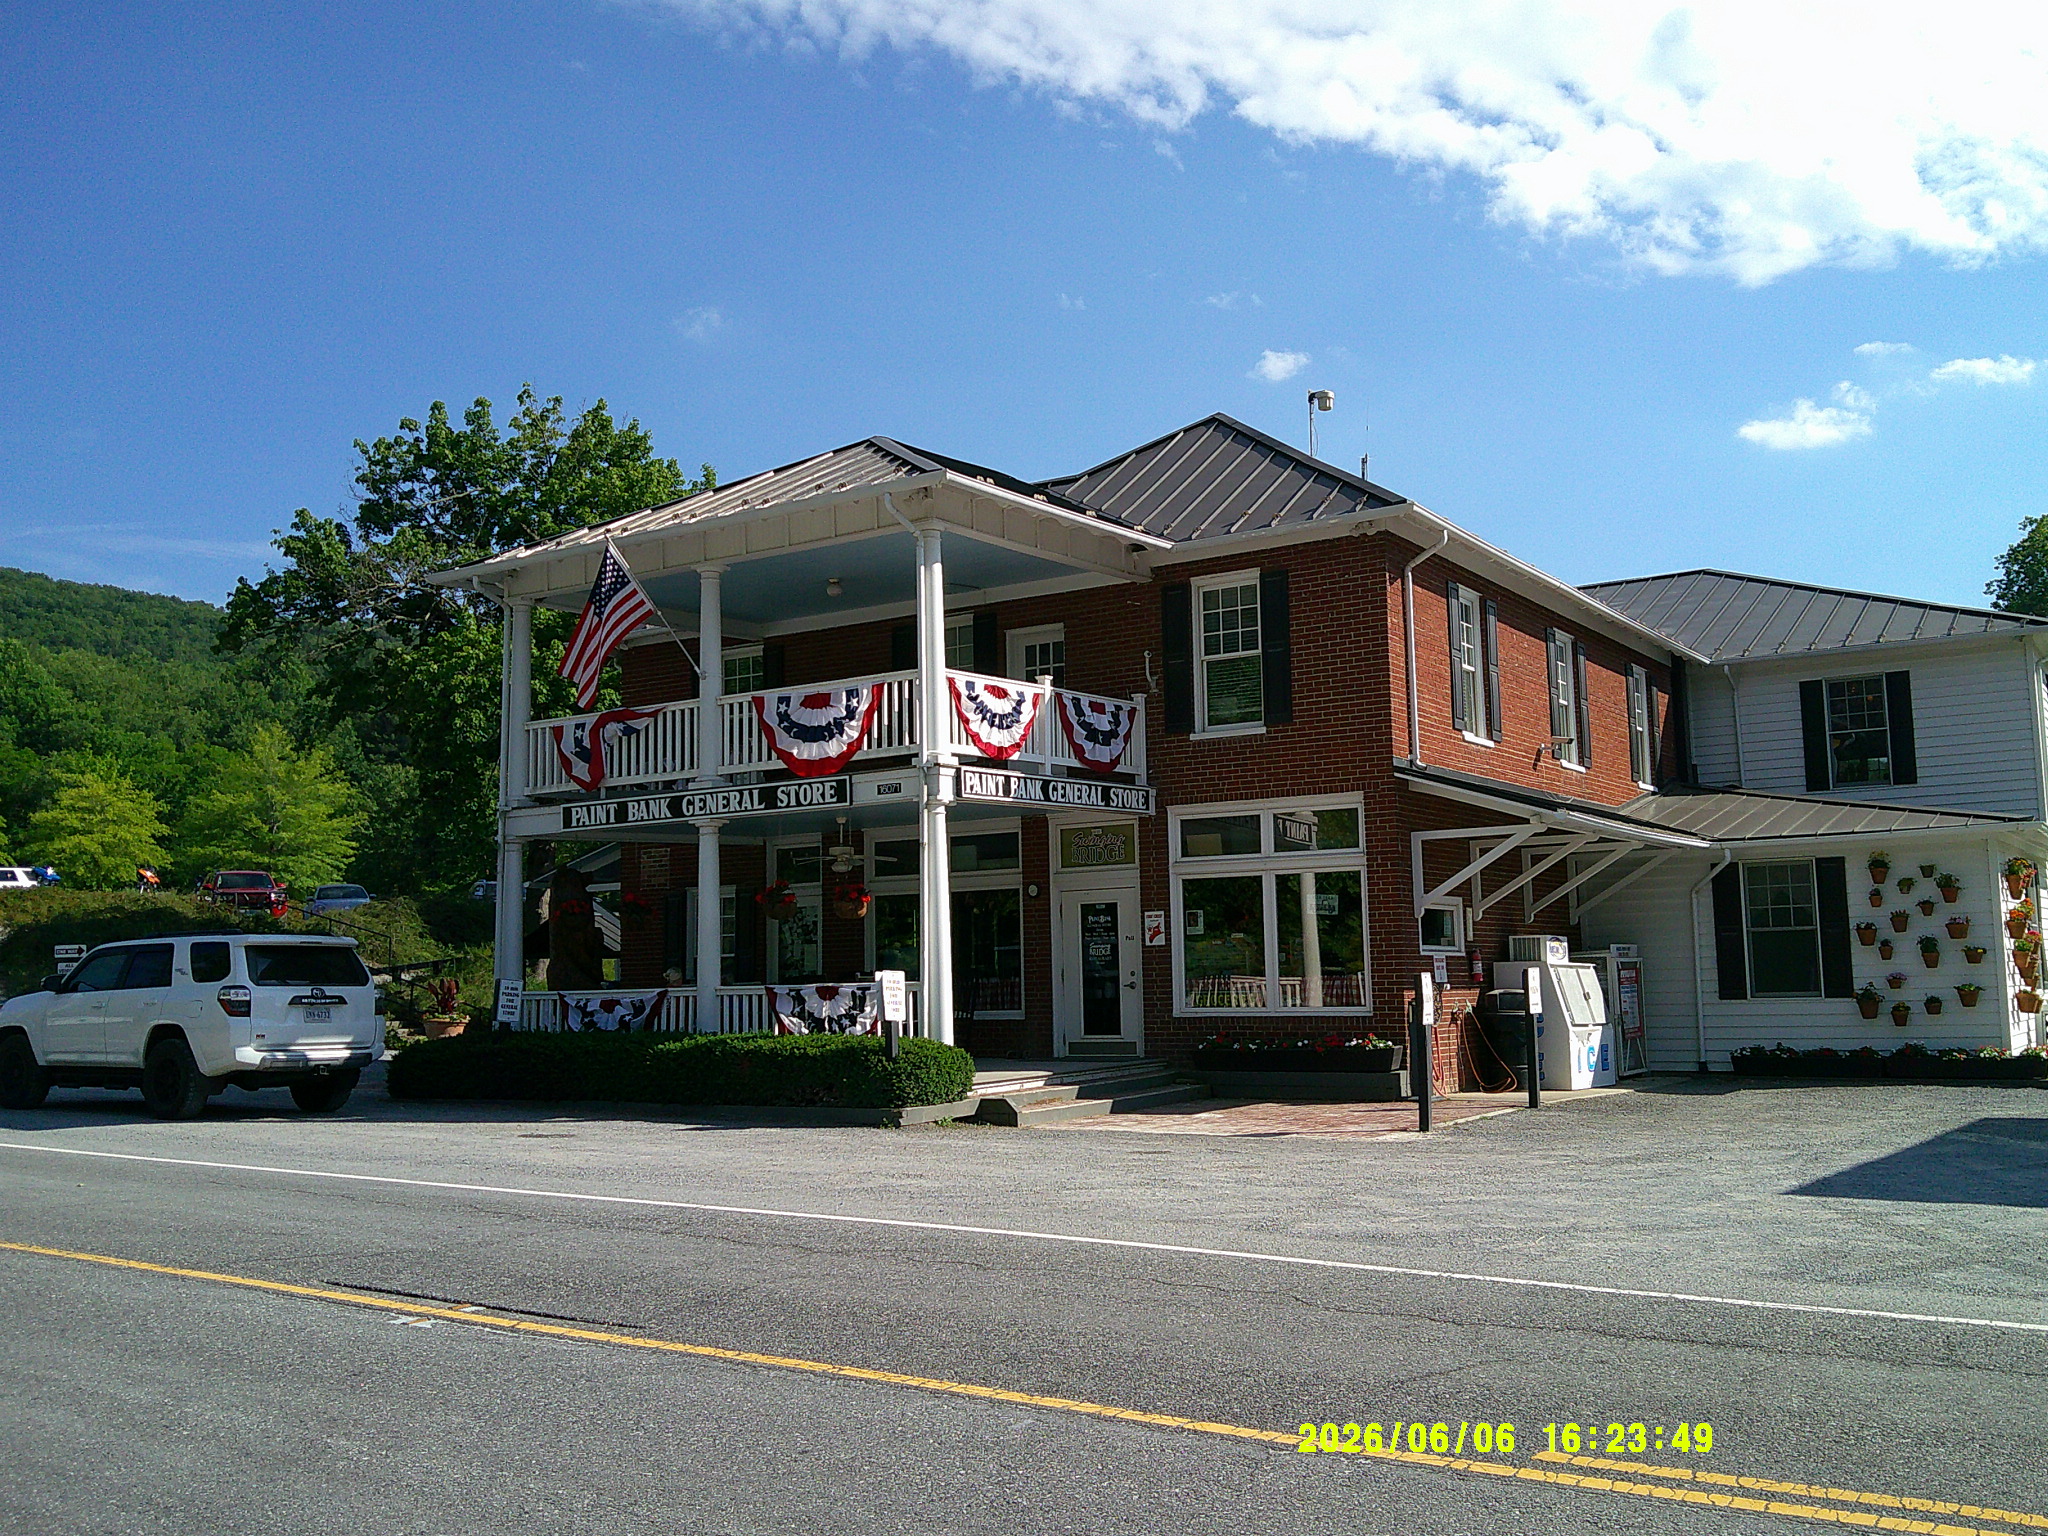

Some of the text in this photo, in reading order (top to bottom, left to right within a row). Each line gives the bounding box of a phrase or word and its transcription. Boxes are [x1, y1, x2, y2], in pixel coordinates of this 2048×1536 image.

[878, 784, 901, 795] 16071
[965, 770, 1147, 809] PAINT BANK GENERAL STORE
[571, 781, 838, 827] PAINT BANK GENERAL STORE
[1072, 831, 1125, 848] Swinging
[1072, 844, 1125, 864] BRIDGE
